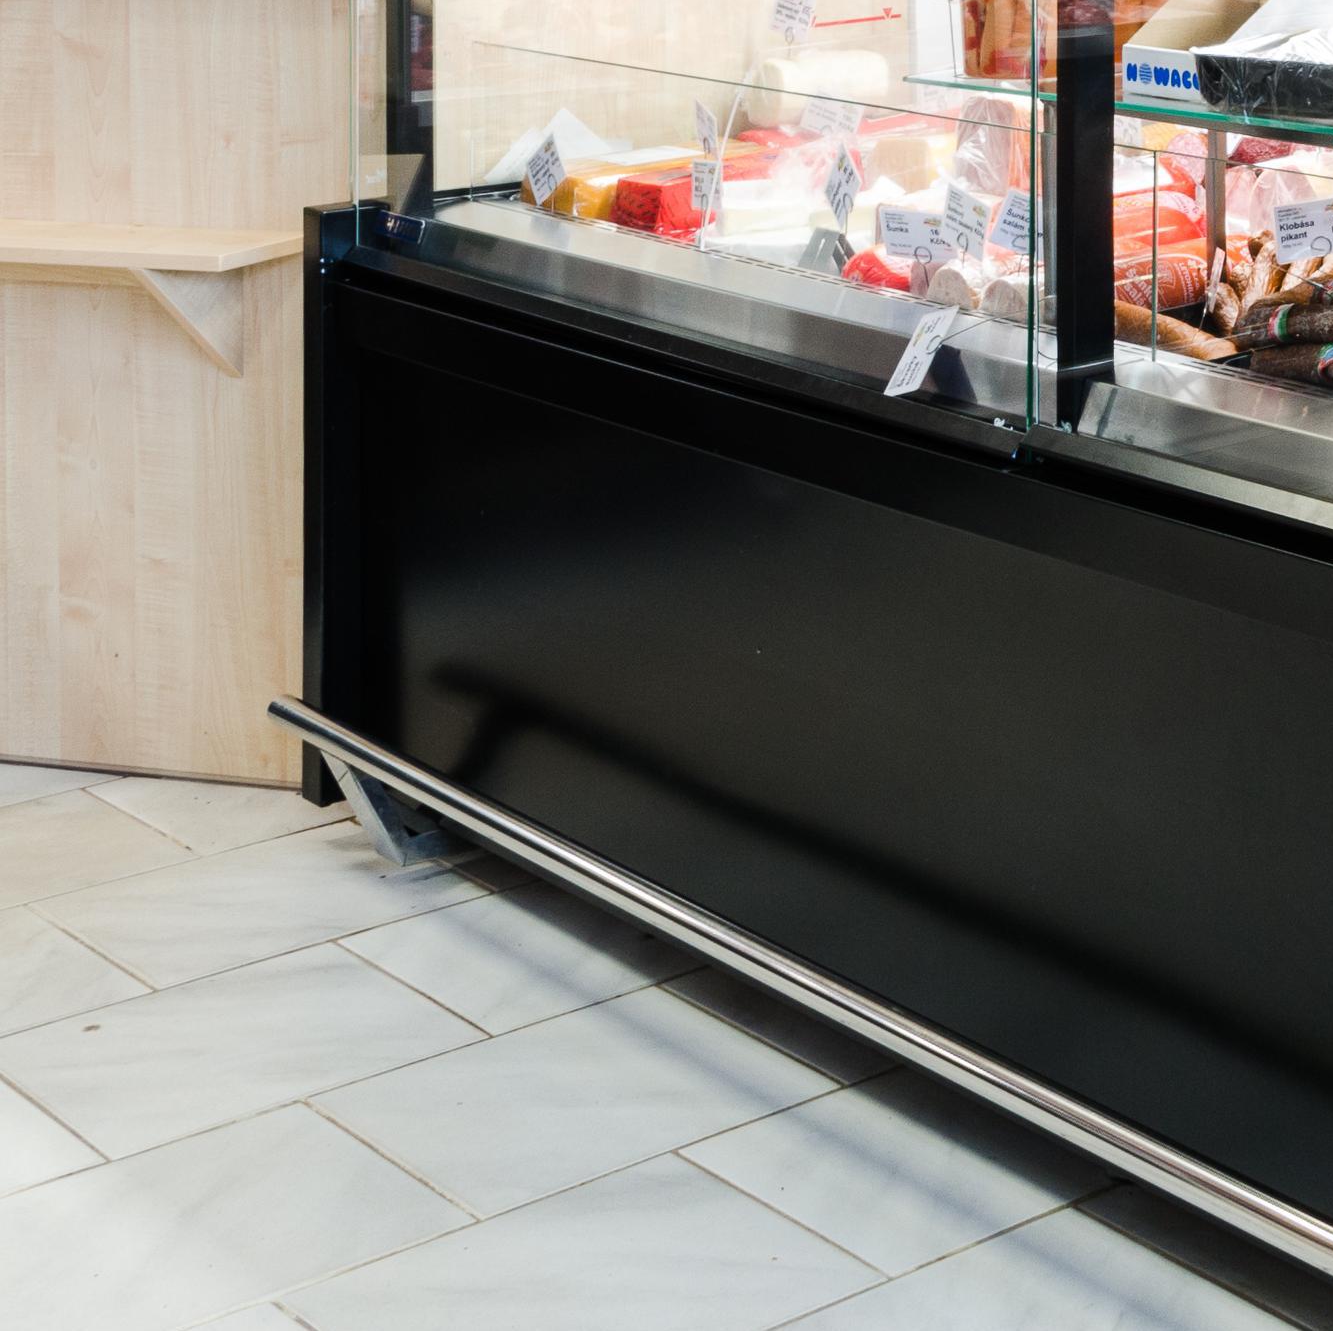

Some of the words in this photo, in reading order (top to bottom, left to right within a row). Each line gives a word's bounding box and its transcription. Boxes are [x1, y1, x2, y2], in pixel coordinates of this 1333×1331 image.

[886, 223, 909, 234] Šunka
[1003, 219, 1025, 231] salám
[1279, 220, 1315, 232] Klobása
[1280, 231, 1308, 243] pikant
